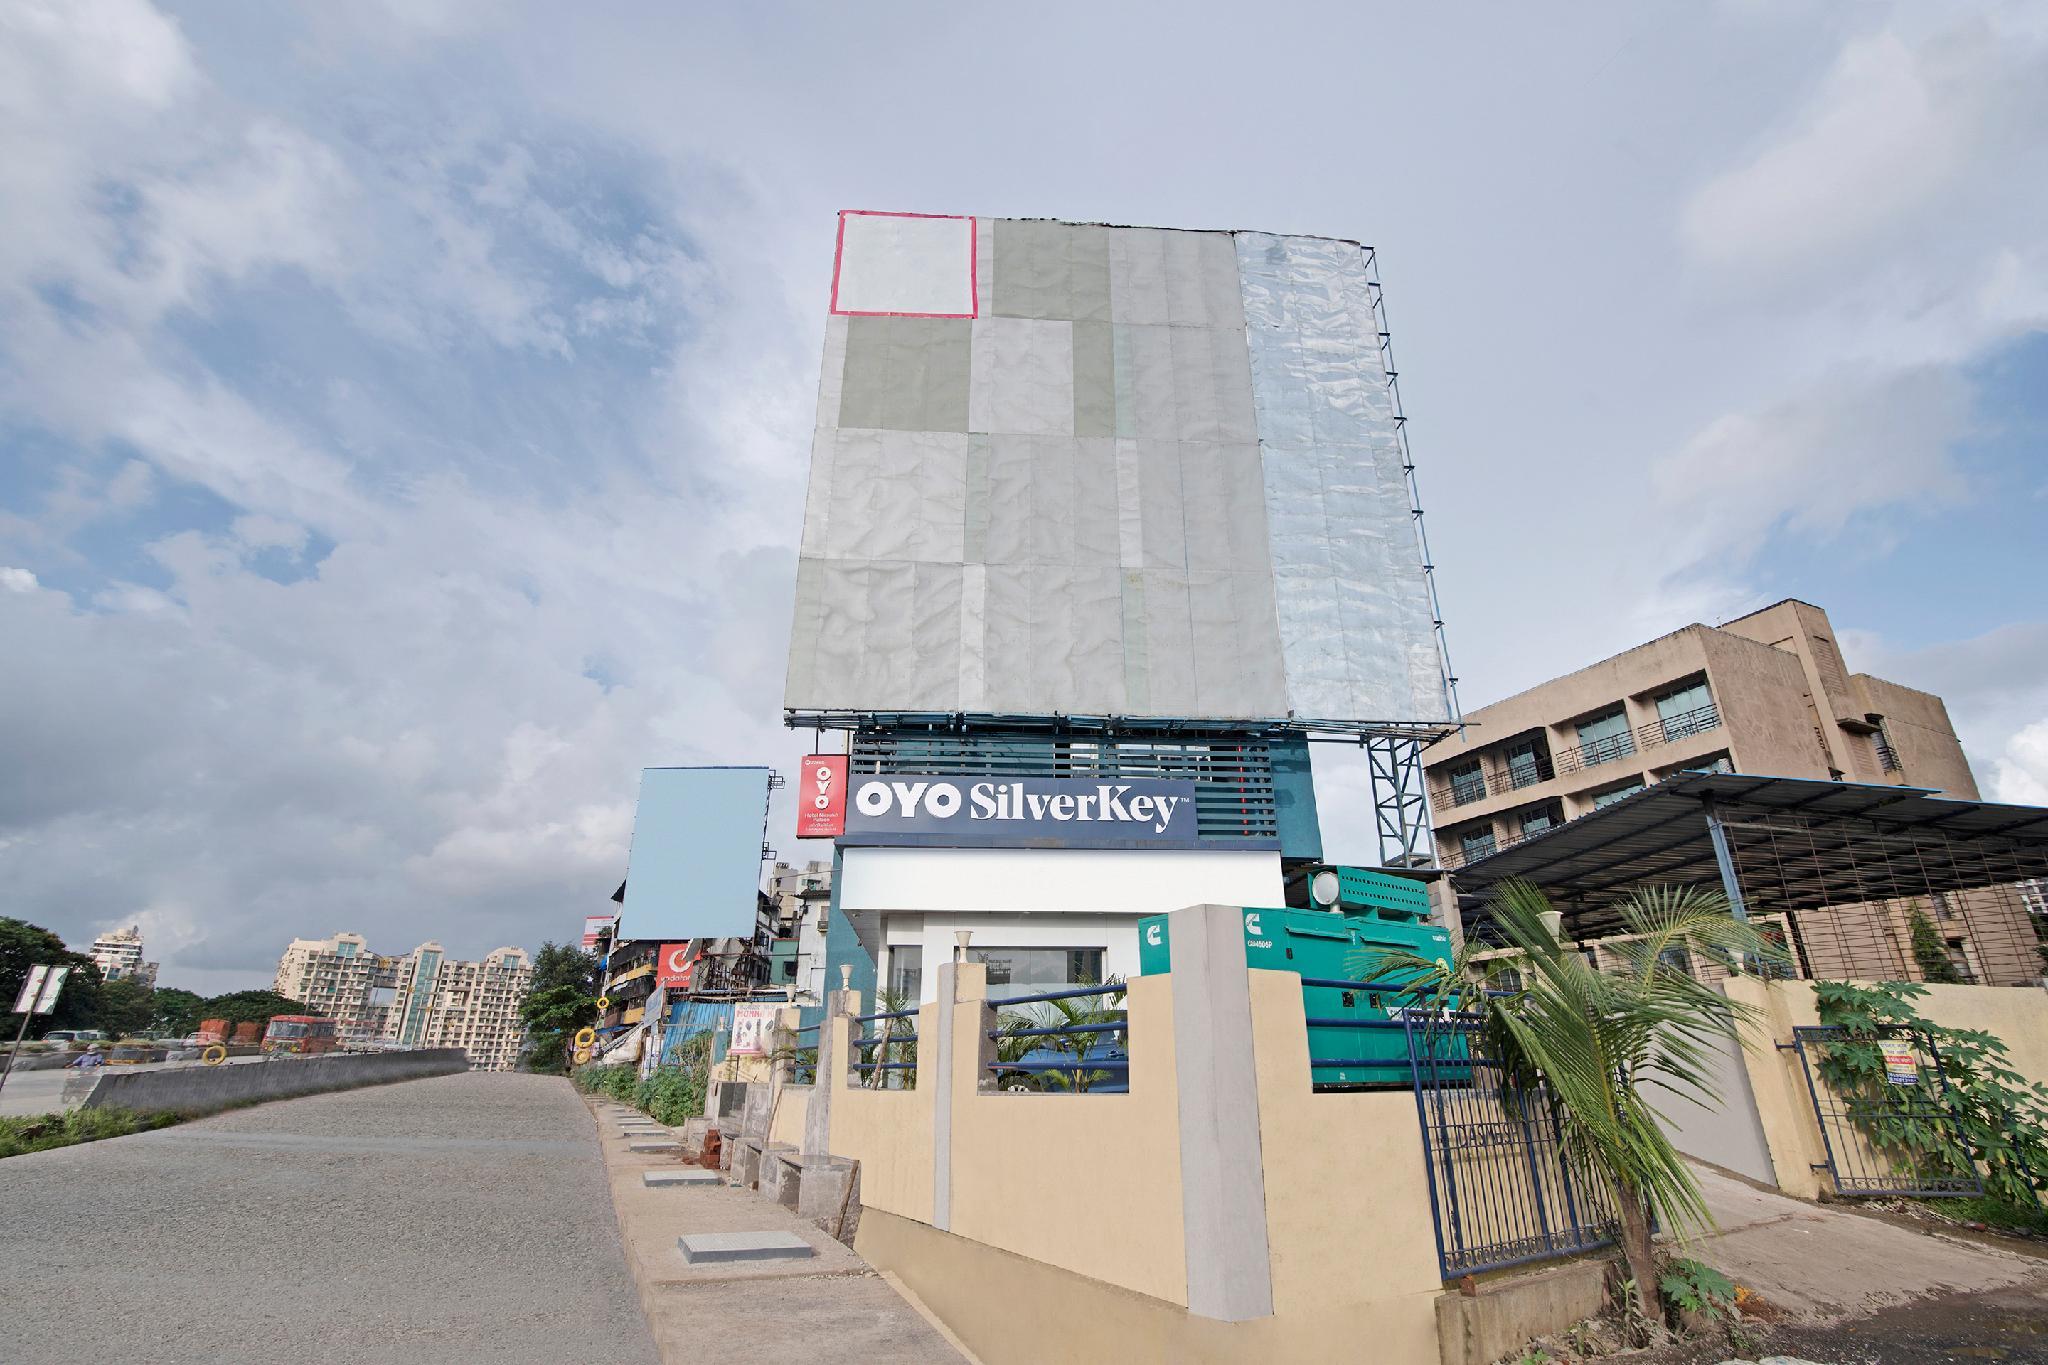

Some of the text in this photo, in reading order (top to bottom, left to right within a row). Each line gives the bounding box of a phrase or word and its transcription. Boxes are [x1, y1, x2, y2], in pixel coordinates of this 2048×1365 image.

[815, 766, 832, 810] OYO
[855, 781, 962, 819] OYO
[970, 782, 1179, 834] SilverKey
[660, 974, 691, 983] vodafon
